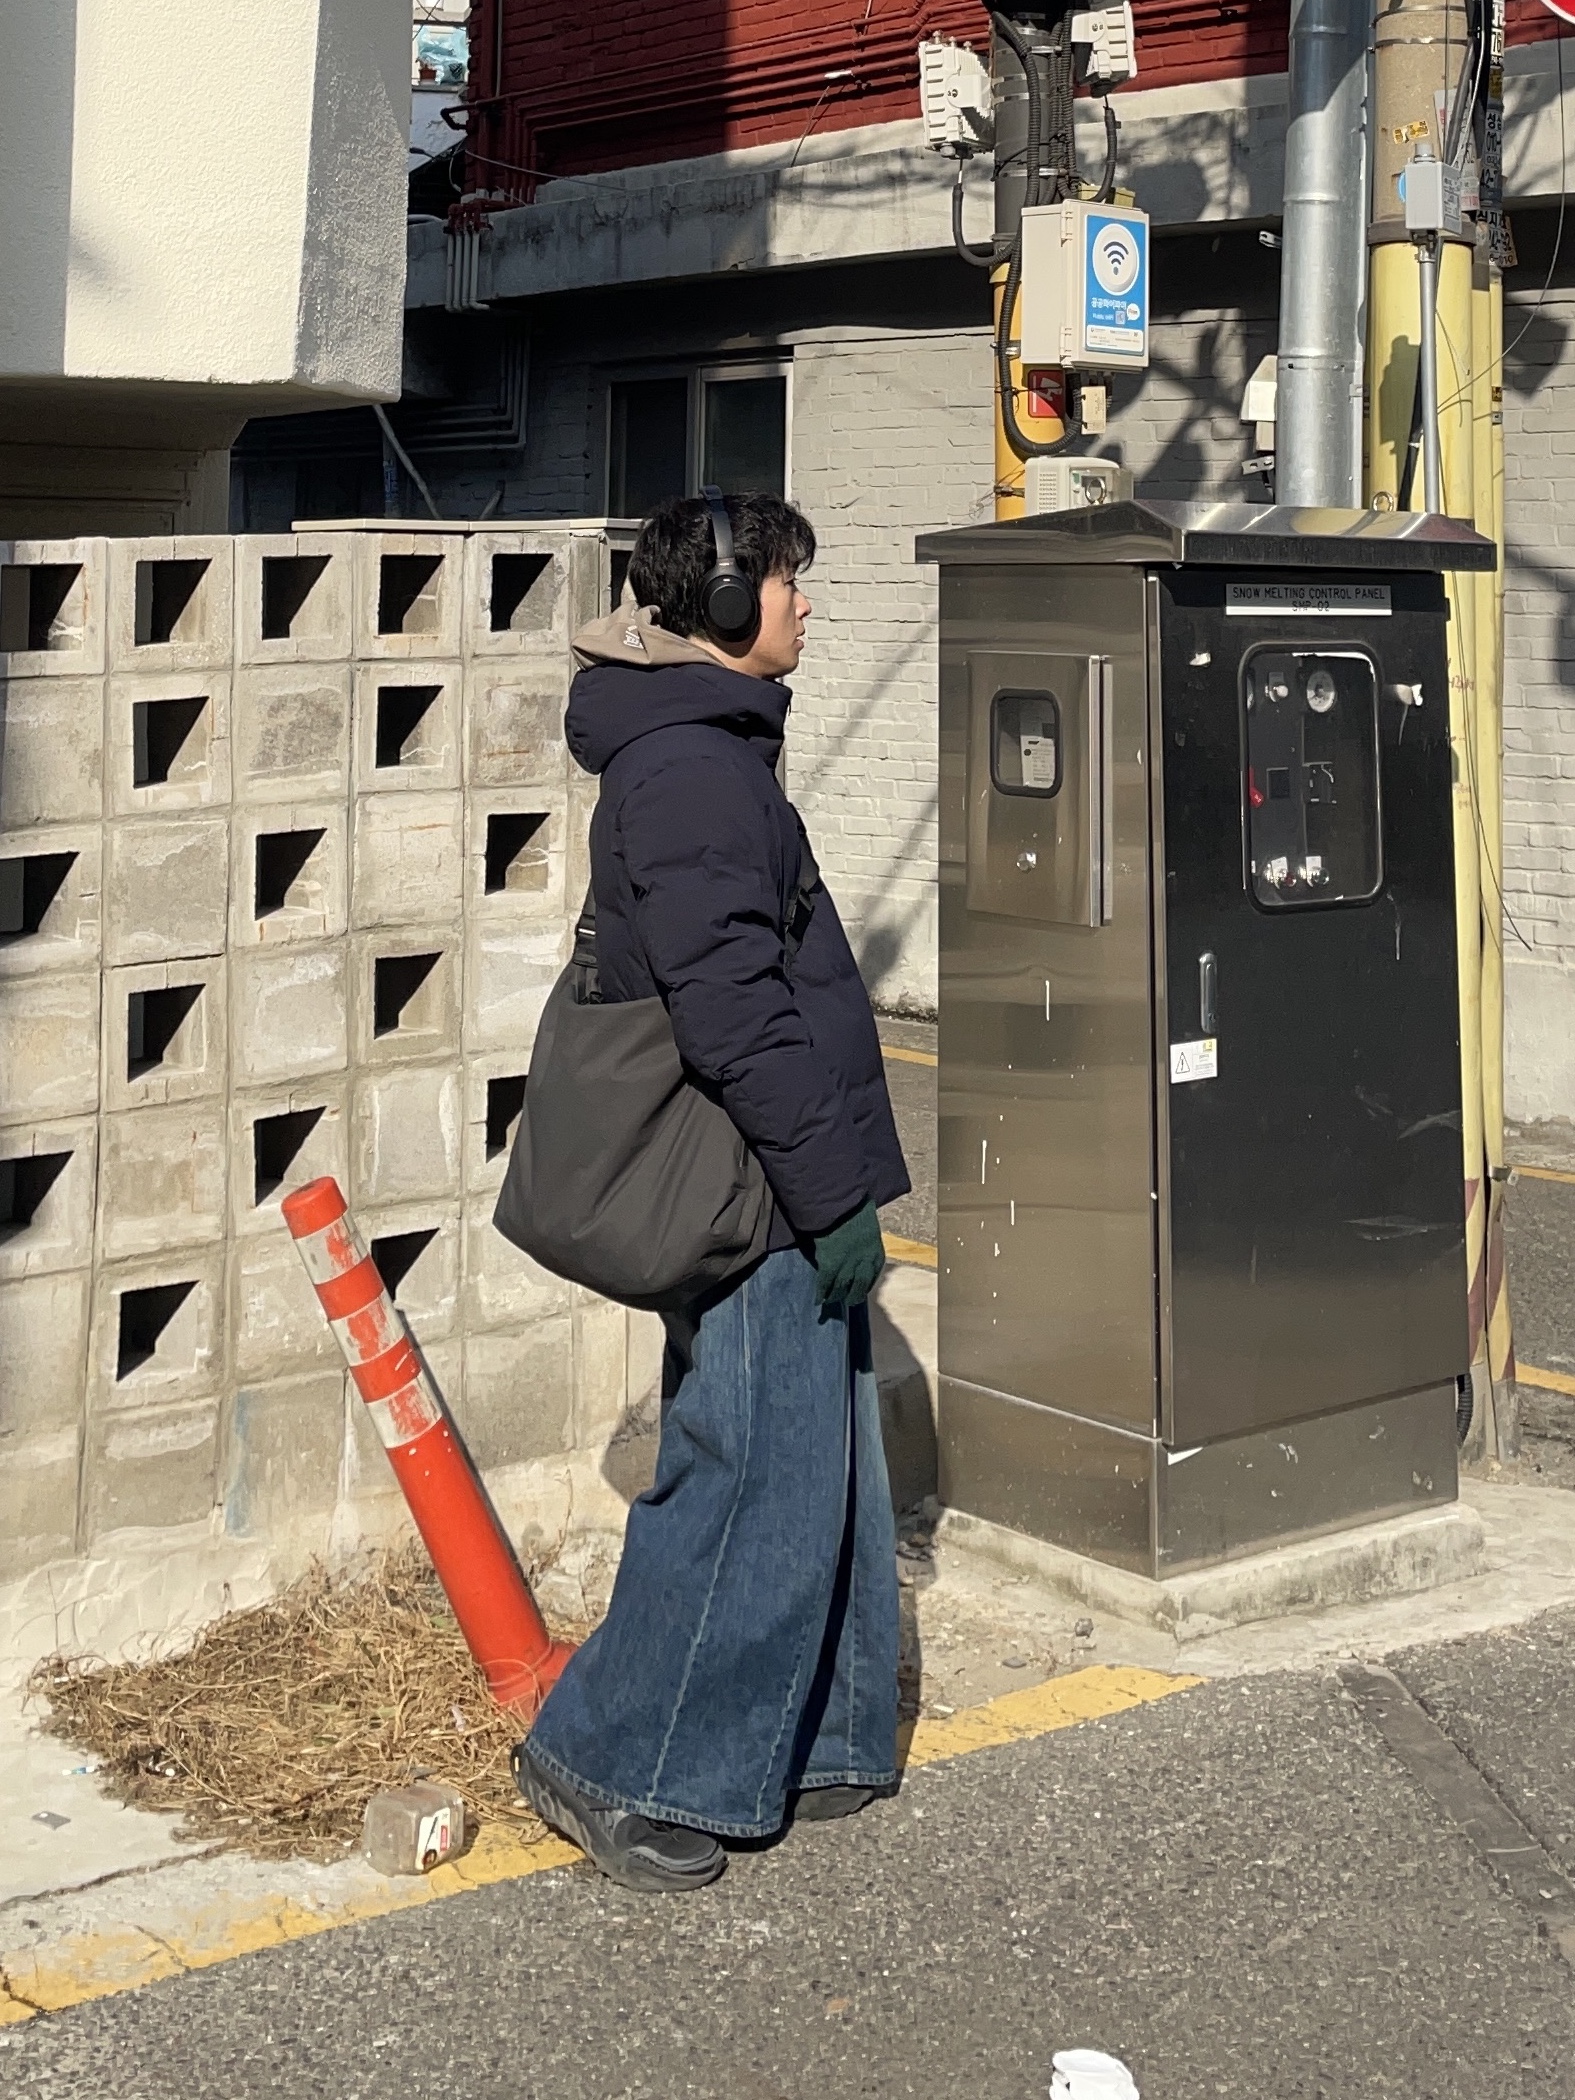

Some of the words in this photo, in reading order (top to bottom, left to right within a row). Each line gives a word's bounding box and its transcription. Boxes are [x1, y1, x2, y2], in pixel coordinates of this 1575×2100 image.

[1232, 586, 1261, 599] SNOW
[1264, 587, 1305, 600] MELTING
[1308, 587, 1352, 600] CONTROL
[1355, 587, 1385, 600] PANEL
